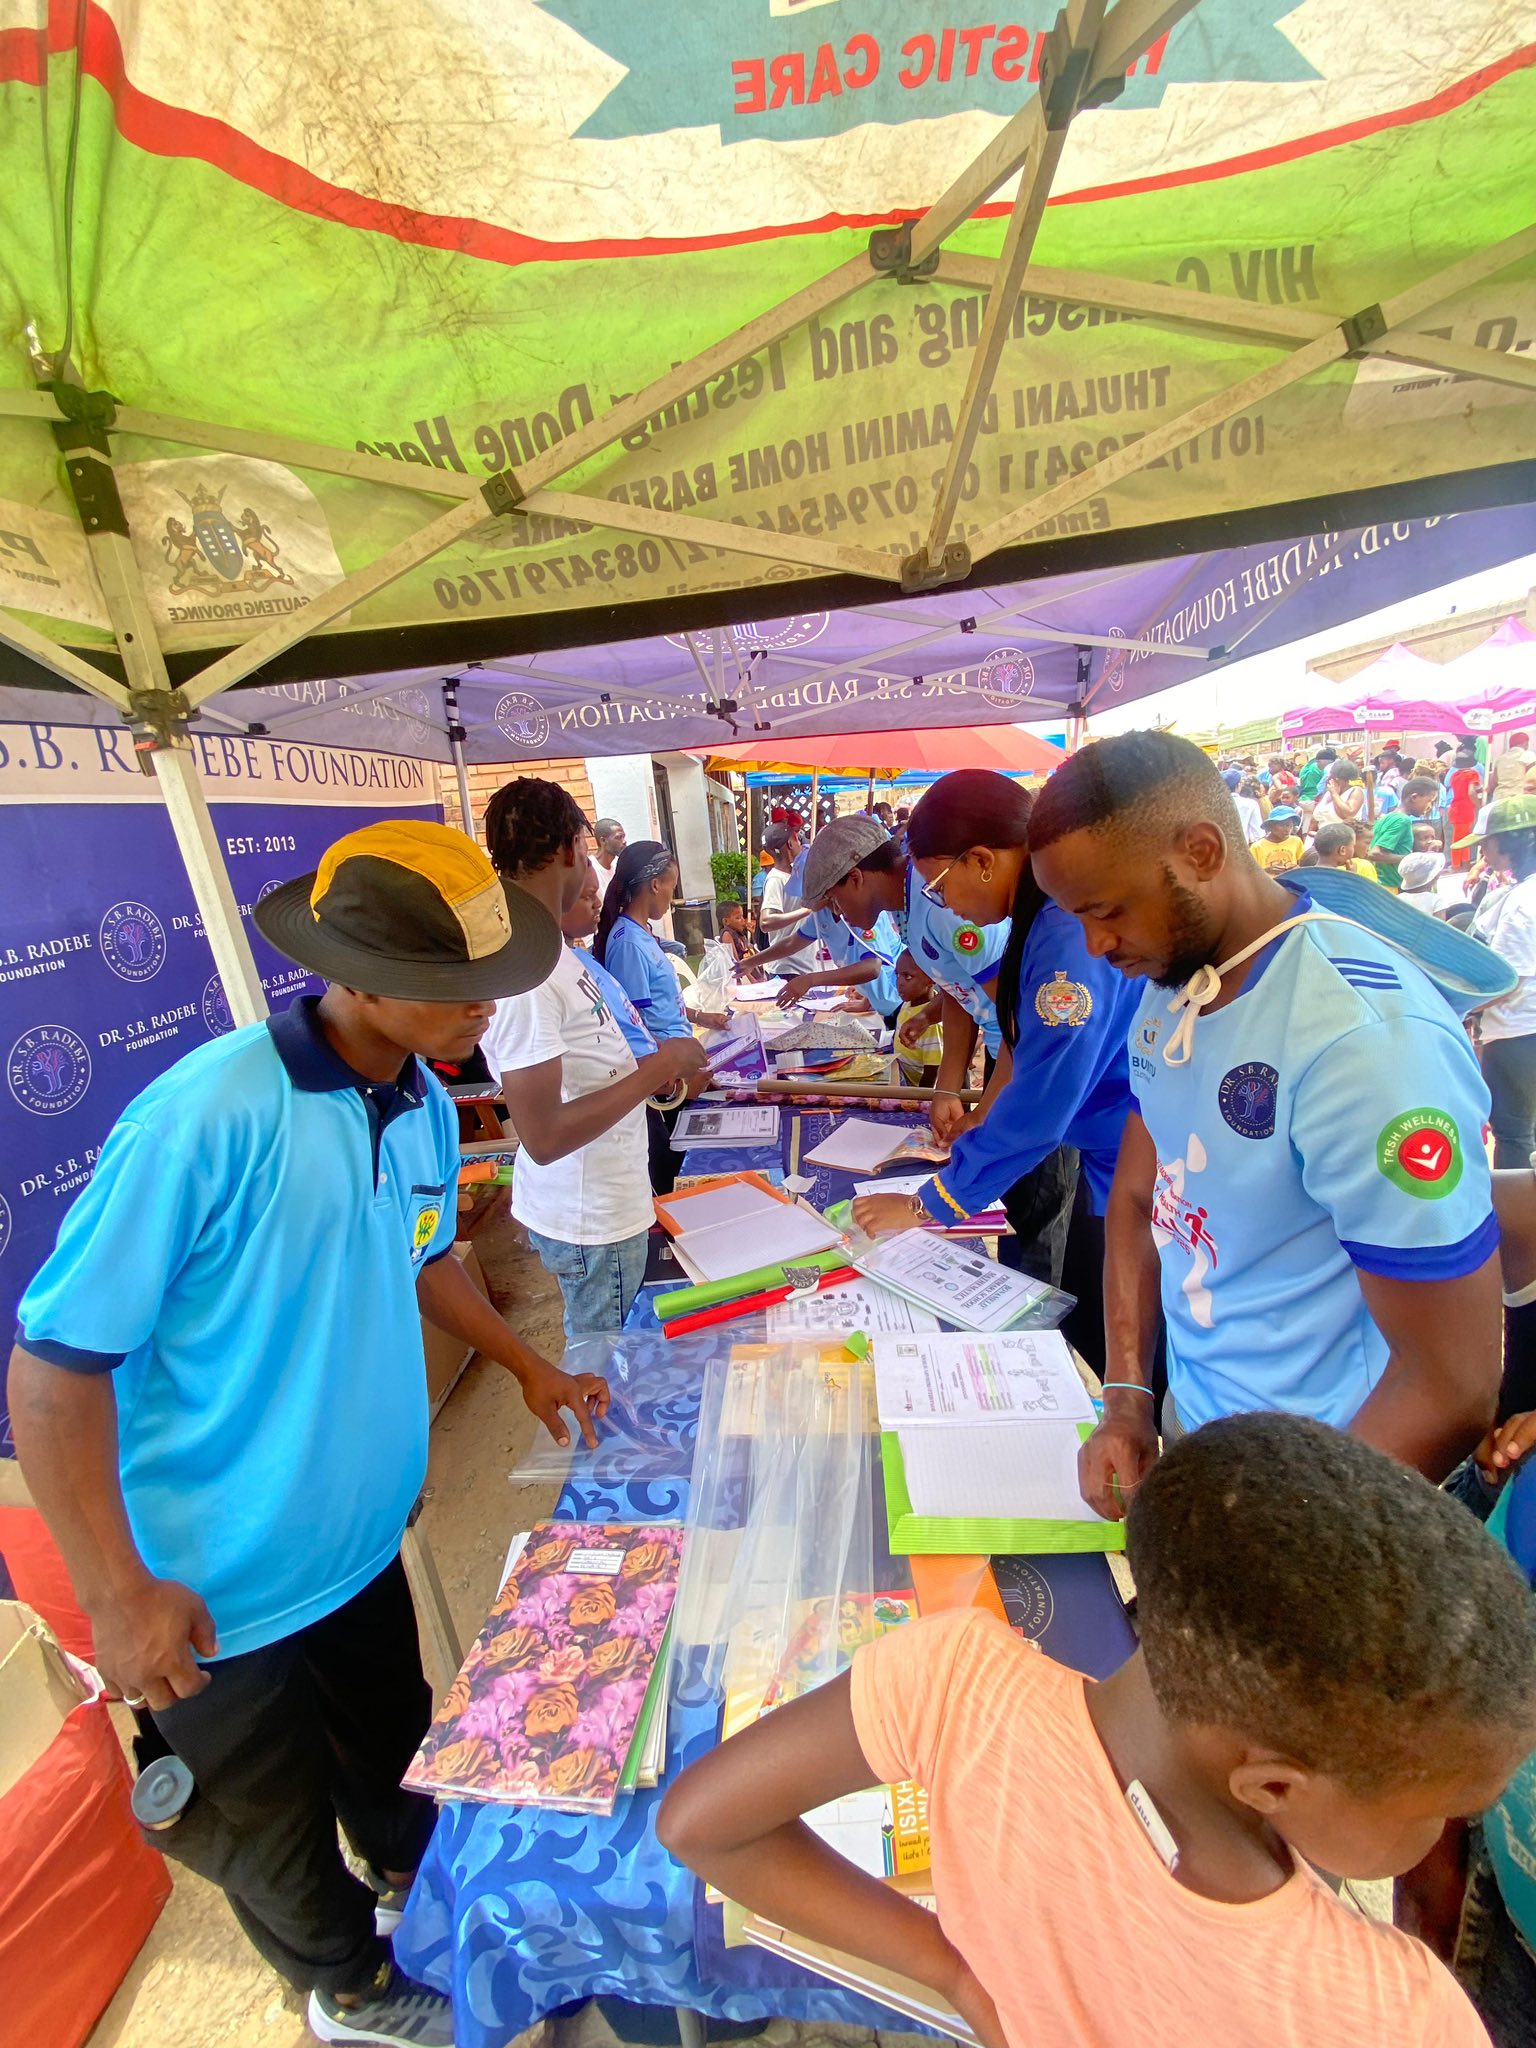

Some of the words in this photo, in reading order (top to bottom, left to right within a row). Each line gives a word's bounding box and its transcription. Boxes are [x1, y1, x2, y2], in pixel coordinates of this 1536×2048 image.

[94, 726, 263, 780] REBE
[271, 744, 425, 789] FOUNDATION
[227, 837, 263, 855] EST:
[265, 835, 297, 853] 2013
[126, 906, 162, 942] RADEBE
[26, 933, 93, 960] RADEBE
[116, 953, 161, 977] FOUNDATION
[271, 981, 307, 998] FOUNDATION
[98, 1031, 125, 1048] DR.
[127, 1020, 150, 1038] S.B.
[150, 1002, 199, 1031] RADEBE
[126, 1026, 180, 1053] FOUNDATION
[17, 1037, 39, 1057] S.B.
[41, 1030, 87, 1064] RADEBE
[29, 1078, 85, 1109] FOUNDATION
[1223, 1109, 1275, 1137] FOUNDATION
[1383, 1131, 1402, 1165] TRSH
[20, 1173, 53, 1197] DR.
[55, 1158, 83, 1180] S.B.
[1011, 1562, 1046, 1630] FOUNDATION
